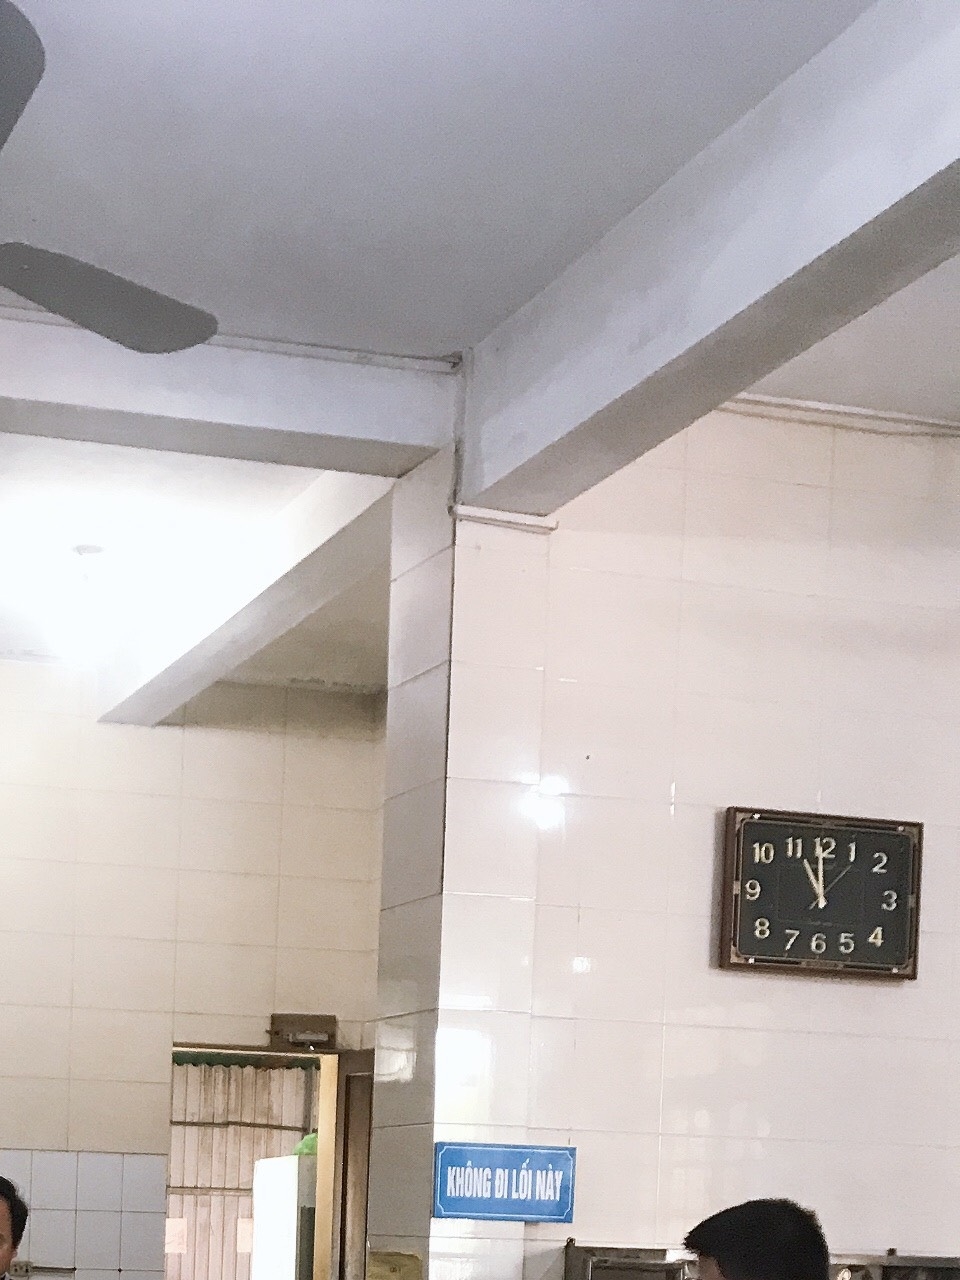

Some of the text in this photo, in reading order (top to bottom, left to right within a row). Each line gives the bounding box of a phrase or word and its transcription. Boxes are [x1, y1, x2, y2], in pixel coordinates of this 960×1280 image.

[752, 842, 774, 863] 10
[785, 836, 803, 859] 11
[813, 837, 836, 859] 12
[848, 842, 856, 862] 1
[872, 852, 888, 874] 2
[745, 879, 761, 900] 9
[881, 890, 897, 911] 3
[754, 918, 770, 939] 8
[868, 926, 884, 947] 4
[785, 929, 800, 950] 7
[810, 933, 826, 954] 6
[838, 932, 855, 954] 5
[447, 1158, 563, 1201] KHÔNG ĐI LỐI NÀY
